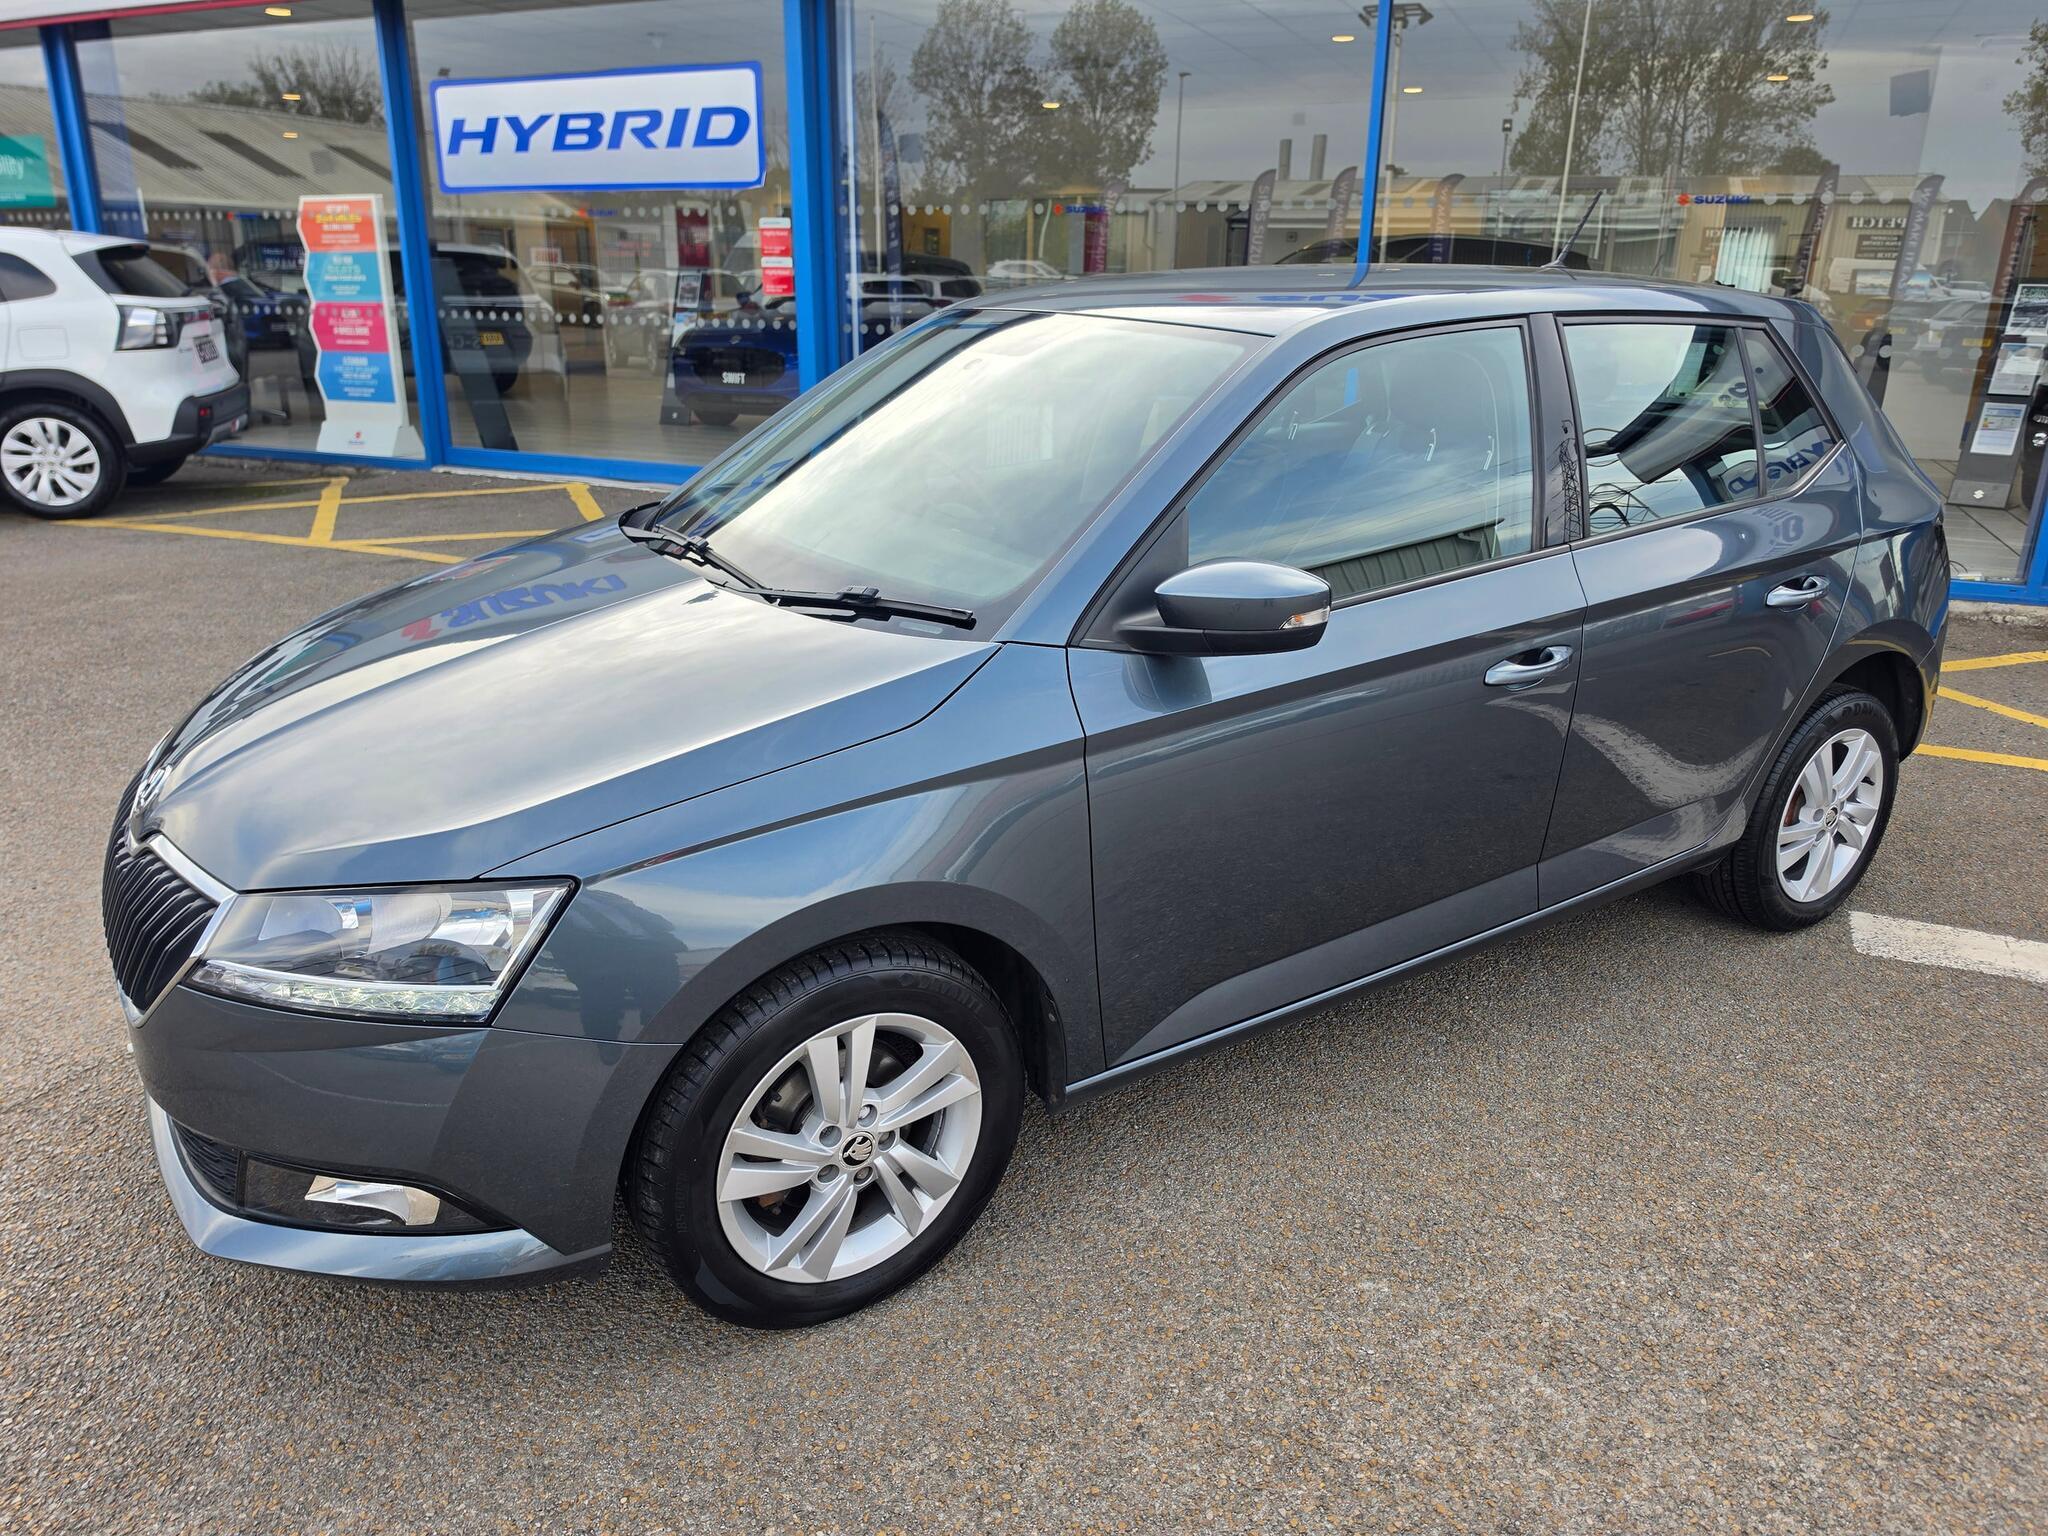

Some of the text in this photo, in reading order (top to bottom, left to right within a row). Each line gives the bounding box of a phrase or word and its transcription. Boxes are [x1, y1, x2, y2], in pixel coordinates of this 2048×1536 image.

[448, 106, 750, 154] HYBRID
[1255, 185, 1270, 221] SIMS
[1694, 195, 1751, 204] SUZUKI
[721, 371, 746, 385] SWIFT
